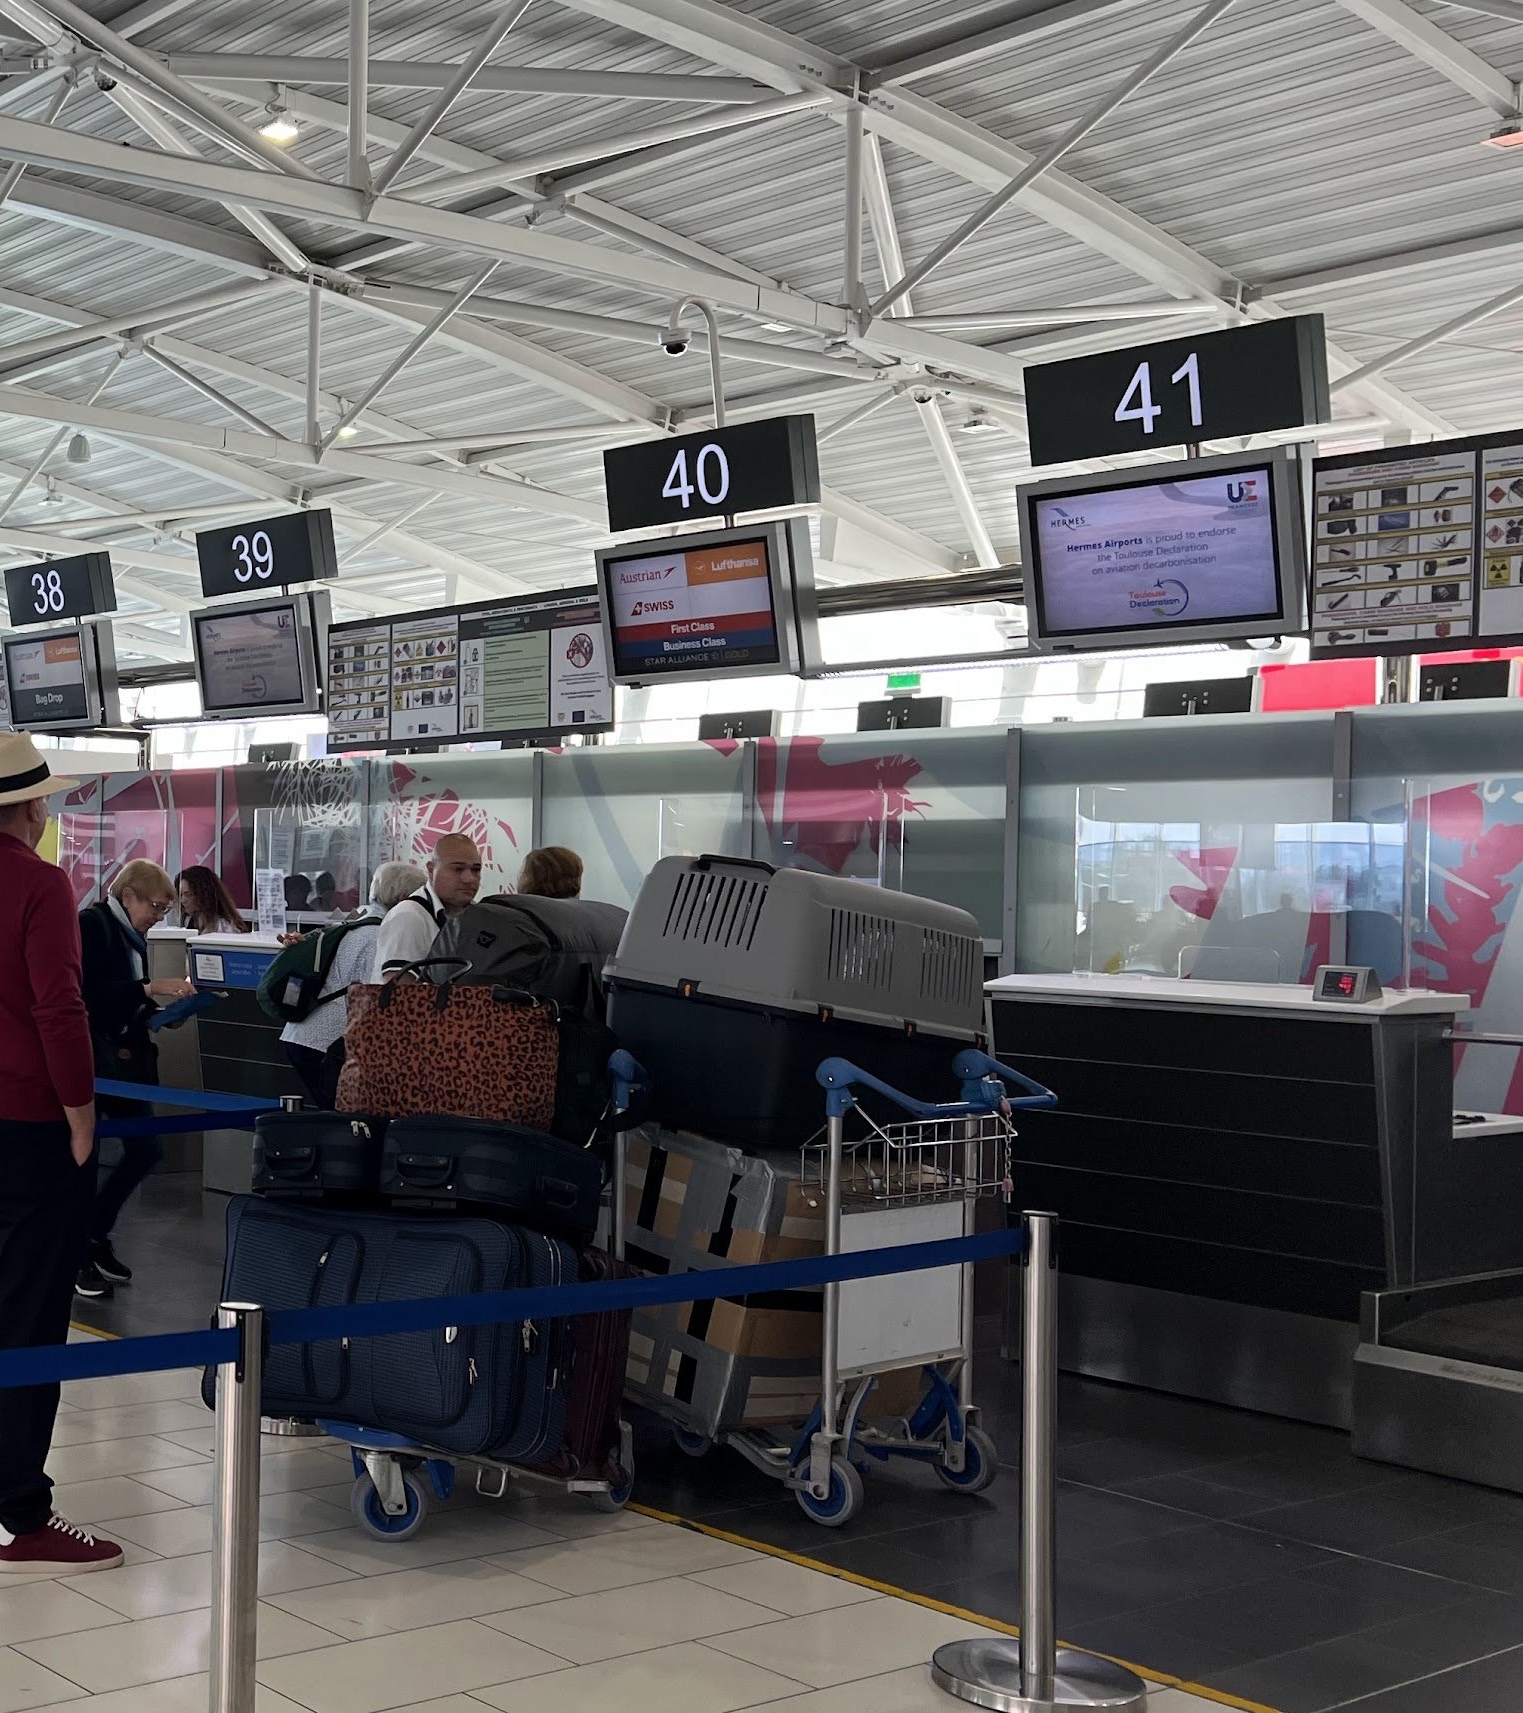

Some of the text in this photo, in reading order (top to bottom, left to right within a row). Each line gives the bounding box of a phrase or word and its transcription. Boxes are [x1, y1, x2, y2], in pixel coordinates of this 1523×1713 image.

[1114, 352, 1203, 434] 41
[661, 443, 729, 508] 40
[1050, 516, 1086, 529] HERMES
[1067, 526, 1237, 552] Hermes Airports is proud to endorse
[231, 530, 274, 583] 39
[1097, 542, 1209, 562] the Toulouse Declaration
[711, 557, 759, 571] Lufthansa
[1092, 554, 1216, 576] on aviation decarbonisation
[620, 570, 661, 584] Austrian
[30, 569, 65, 615] 38
[1129, 589, 1167, 599] Toulouse
[644, 600, 674, 612] SWISS
[1130, 597, 1180, 608] Declaration
[671, 622, 715, 634] First Class
[663, 637, 726, 651] Business Class
[645, 656, 667, 666] STAR
[668, 653, 710, 665] ALLIANCE
[35, 693, 63, 705] Bag Drop
